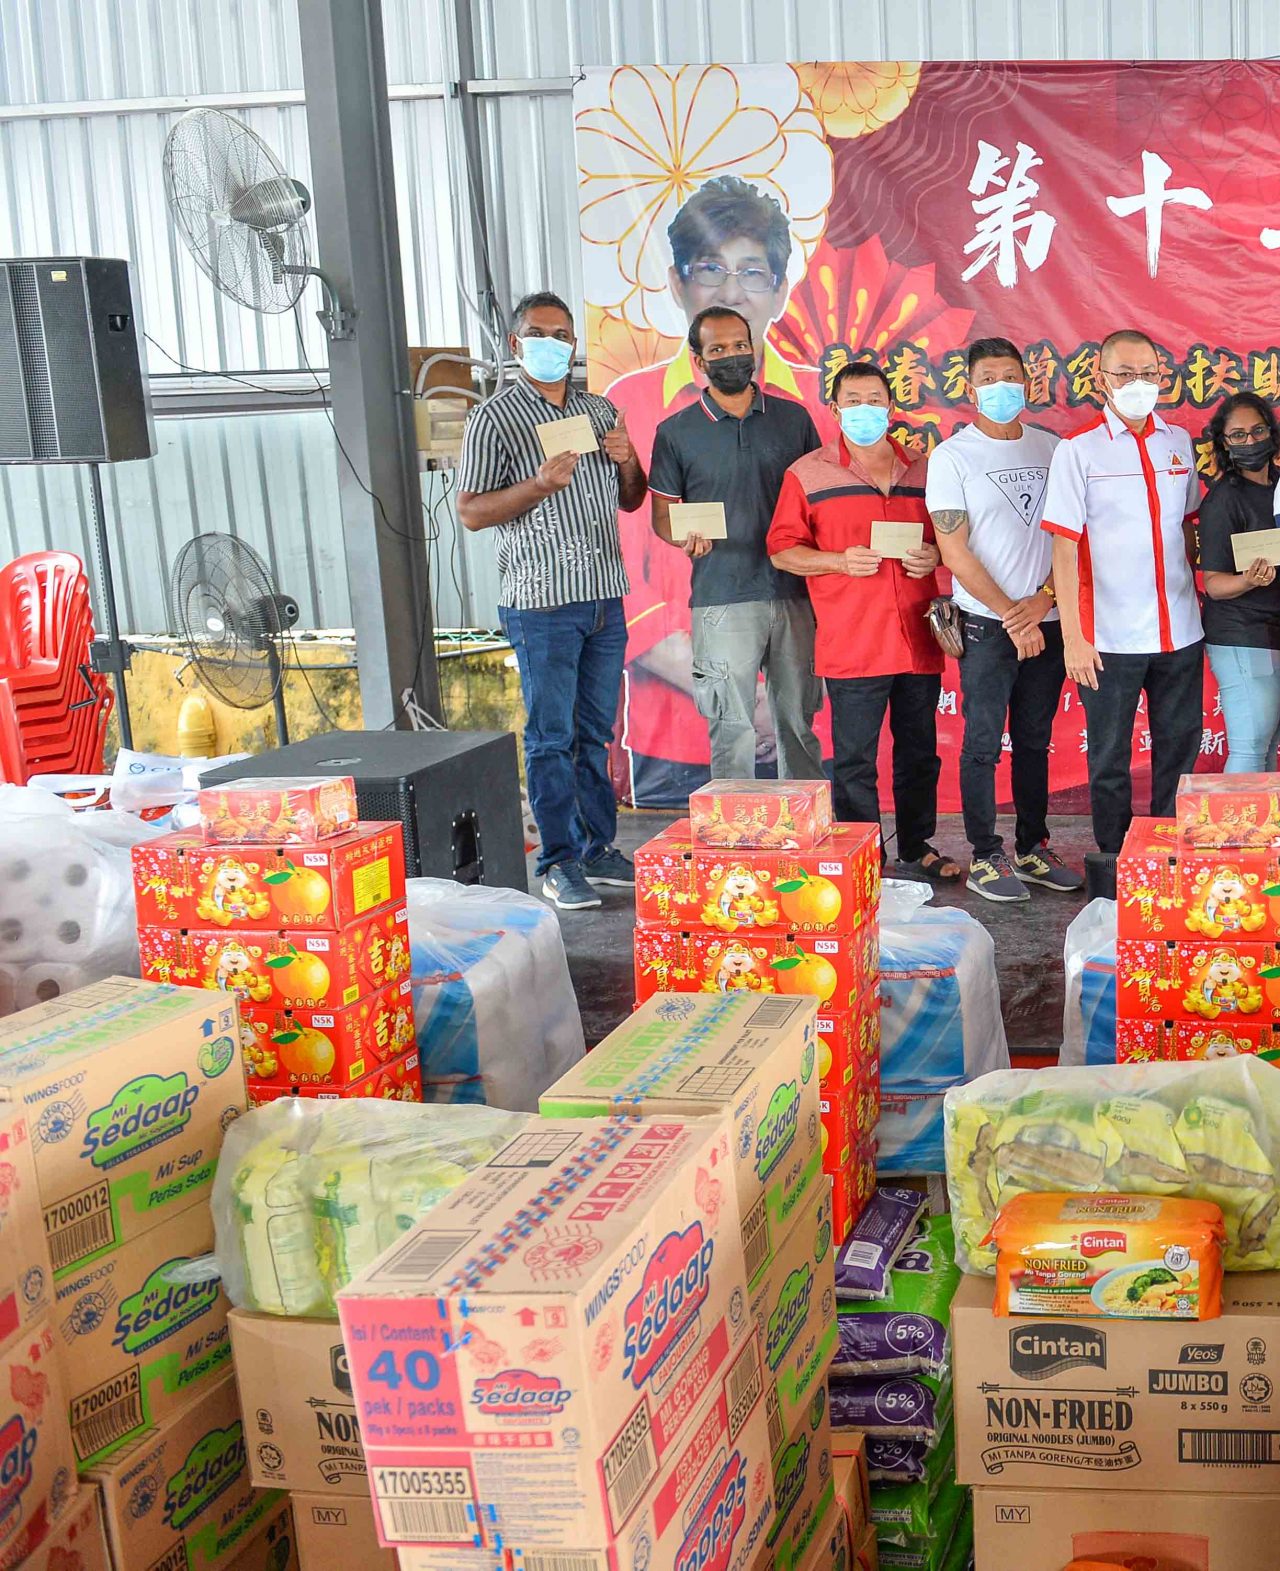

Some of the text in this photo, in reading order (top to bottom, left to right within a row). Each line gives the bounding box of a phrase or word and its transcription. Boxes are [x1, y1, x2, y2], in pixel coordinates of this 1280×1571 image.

[998, 470, 1044, 484] GUESS
[306, 855, 326, 863] NSK
[821, 864, 841, 873] NSK
[308, 940, 327, 948] NSK
[816, 942, 836, 952] NSK
[313, 1015, 333, 1026] NSK
[23, 1070, 84, 1105] WINGSFOOD
[80, 1084, 200, 1159] Sedaap
[111, 1104, 128, 1121] Mi
[754, 1090, 801, 1175] Sedaap
[156, 1149, 203, 1181] Mi Sup
[185, 1167, 212, 1191] Soto
[43, 1186, 108, 1232] 17000012
[1083, 1235, 1124, 1249] Cintan
[1024, 1258, 1087, 1271] NON FRIED
[56, 1260, 115, 1300] WINGSFOOD
[584, 1237, 646, 1328] WINGSFOOD
[1035, 1271, 1056, 1279] Tanpa
[1058, 1271, 1087, 1280] Goreng
[142, 1288, 159, 1306] Mi
[643, 1285, 657, 1312] Mi
[623, 1237, 714, 1381] Sedaap
[764, 1279, 815, 1359] Sedaap
[351, 1323, 437, 1341] Isi Content
[895, 1324, 926, 1340] 5%
[186, 1342, 203, 1360] Mi
[1015, 1335, 1100, 1357] Cintan
[1187, 1347, 1218, 1361] Yeo's
[658, 1328, 697, 1387] FAVOURITE
[367, 1349, 441, 1391] 40
[659, 1347, 711, 1423] MI GORENG
[1152, 1374, 1224, 1393] JUMBO
[72, 1372, 138, 1421] 17000012
[469, 1386, 572, 1415] Sedaap
[885, 1392, 916, 1409] 5%
[364, 1399, 456, 1419] pek packs
[985, 1397, 1133, 1433] NON-FRIED
[1180, 1401, 1188, 1411] 8
[1198, 1401, 1219, 1411] 550
[1221, 1404, 1228, 1414] g
[602, 1406, 649, 1482] 17005355
[986, 1432, 1115, 1447] ORIGINAL NOODLES (JUMBO)
[988, 1451, 1001, 1462] MI
[1003, 1450, 1036, 1460] TANPA
[323, 1462, 339, 1472] MI
[378, 1470, 466, 1497] 17005355
[317, 1510, 340, 1522] MY
[1000, 1507, 1026, 1520] MY
